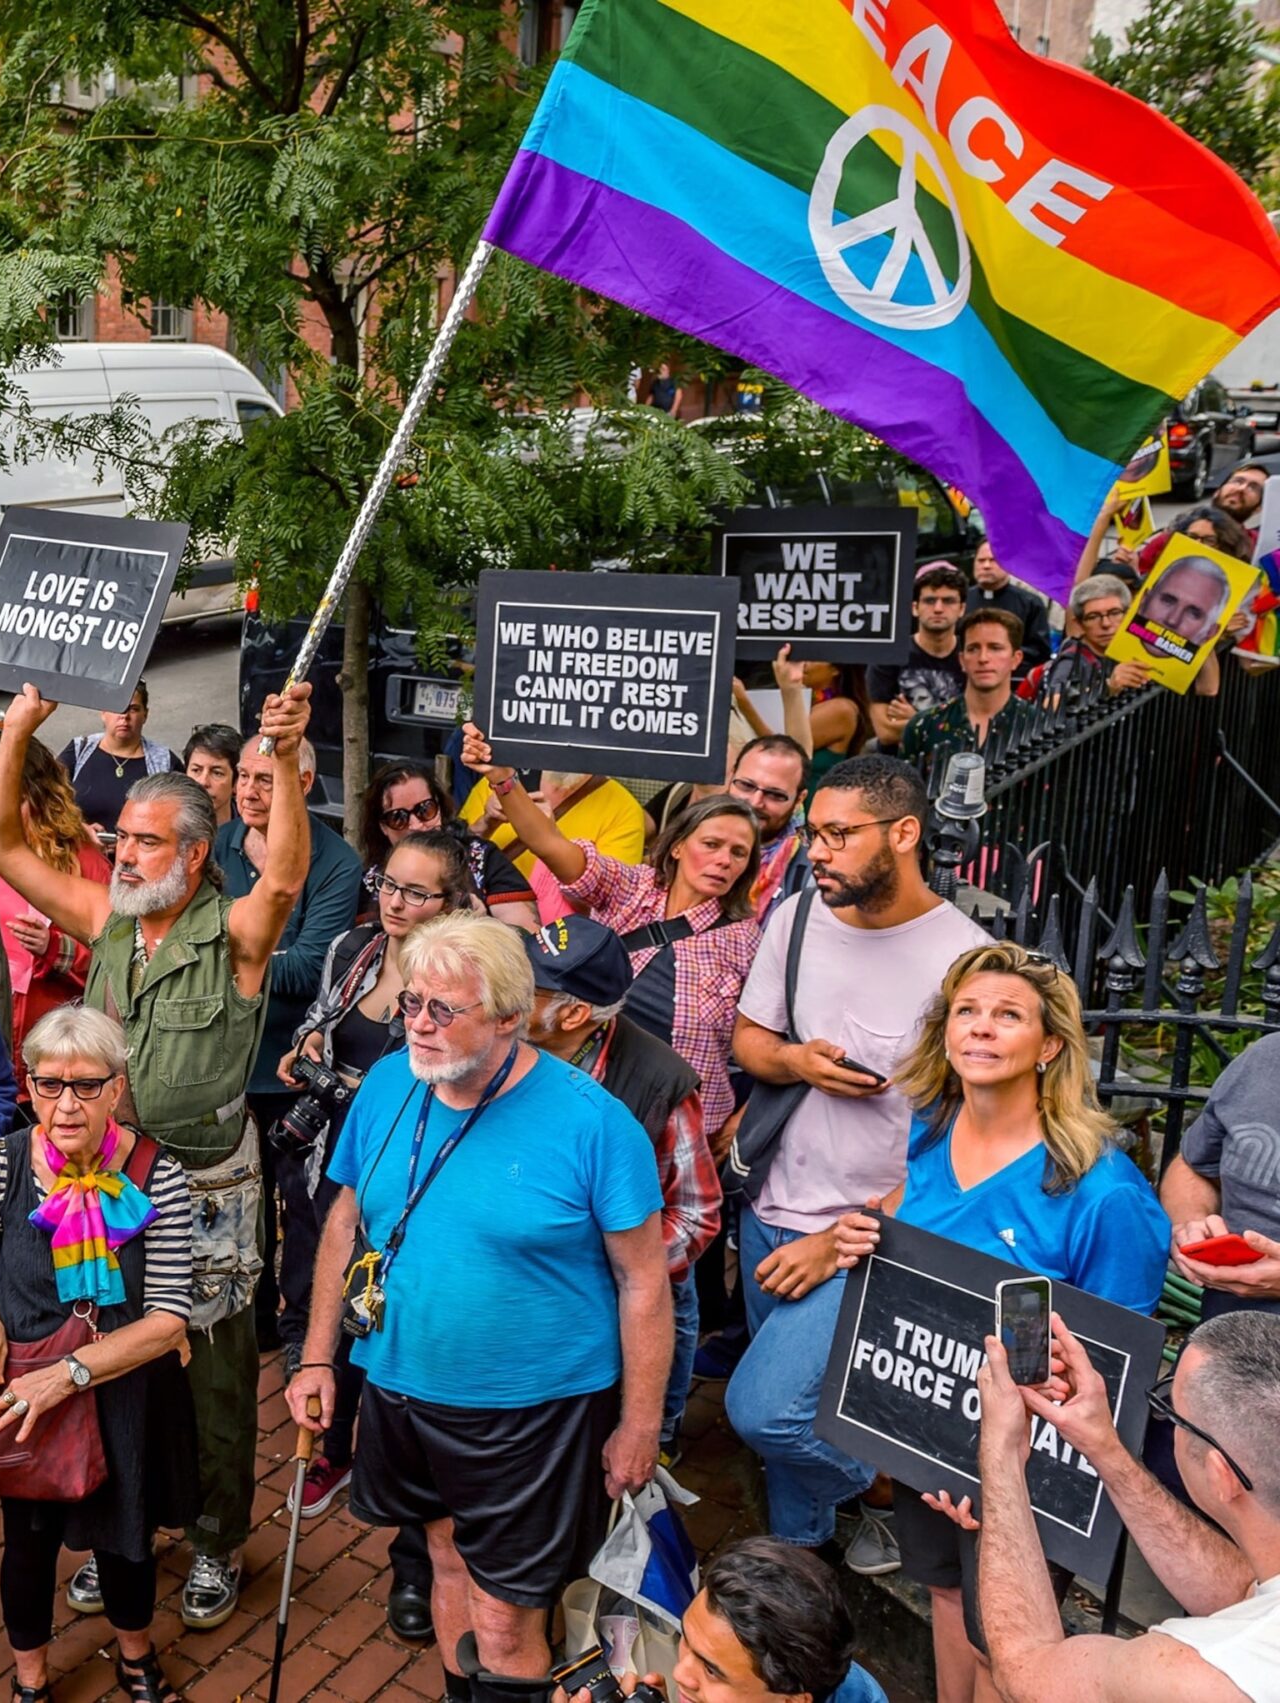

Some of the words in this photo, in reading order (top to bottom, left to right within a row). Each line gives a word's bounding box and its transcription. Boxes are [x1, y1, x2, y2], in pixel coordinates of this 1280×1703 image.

[852, 0, 1115, 247] EACE
[780, 542, 837, 571] WE
[23, 570, 90, 607] LOVE
[89, 579, 118, 612] IS
[754, 573, 862, 601] WANT
[737, 603, 890, 632] RESPECT
[101, 619, 139, 652] US
[499, 622, 536, 646] WE
[542, 624, 599, 650] WHO
[606, 627, 713, 656] BELIEVE
[527, 650, 553, 673] IN
[560, 652, 679, 681] FREEDOM
[515, 675, 616, 703] CANNOT
[621, 681, 688, 708] REST
[501, 700, 573, 727] UNTIL
[580, 705, 605, 729] IT
[609, 708, 699, 737] COMES
[893, 1316, 988, 1382] TRUM
[853, 1338, 956, 1410] FORCE
